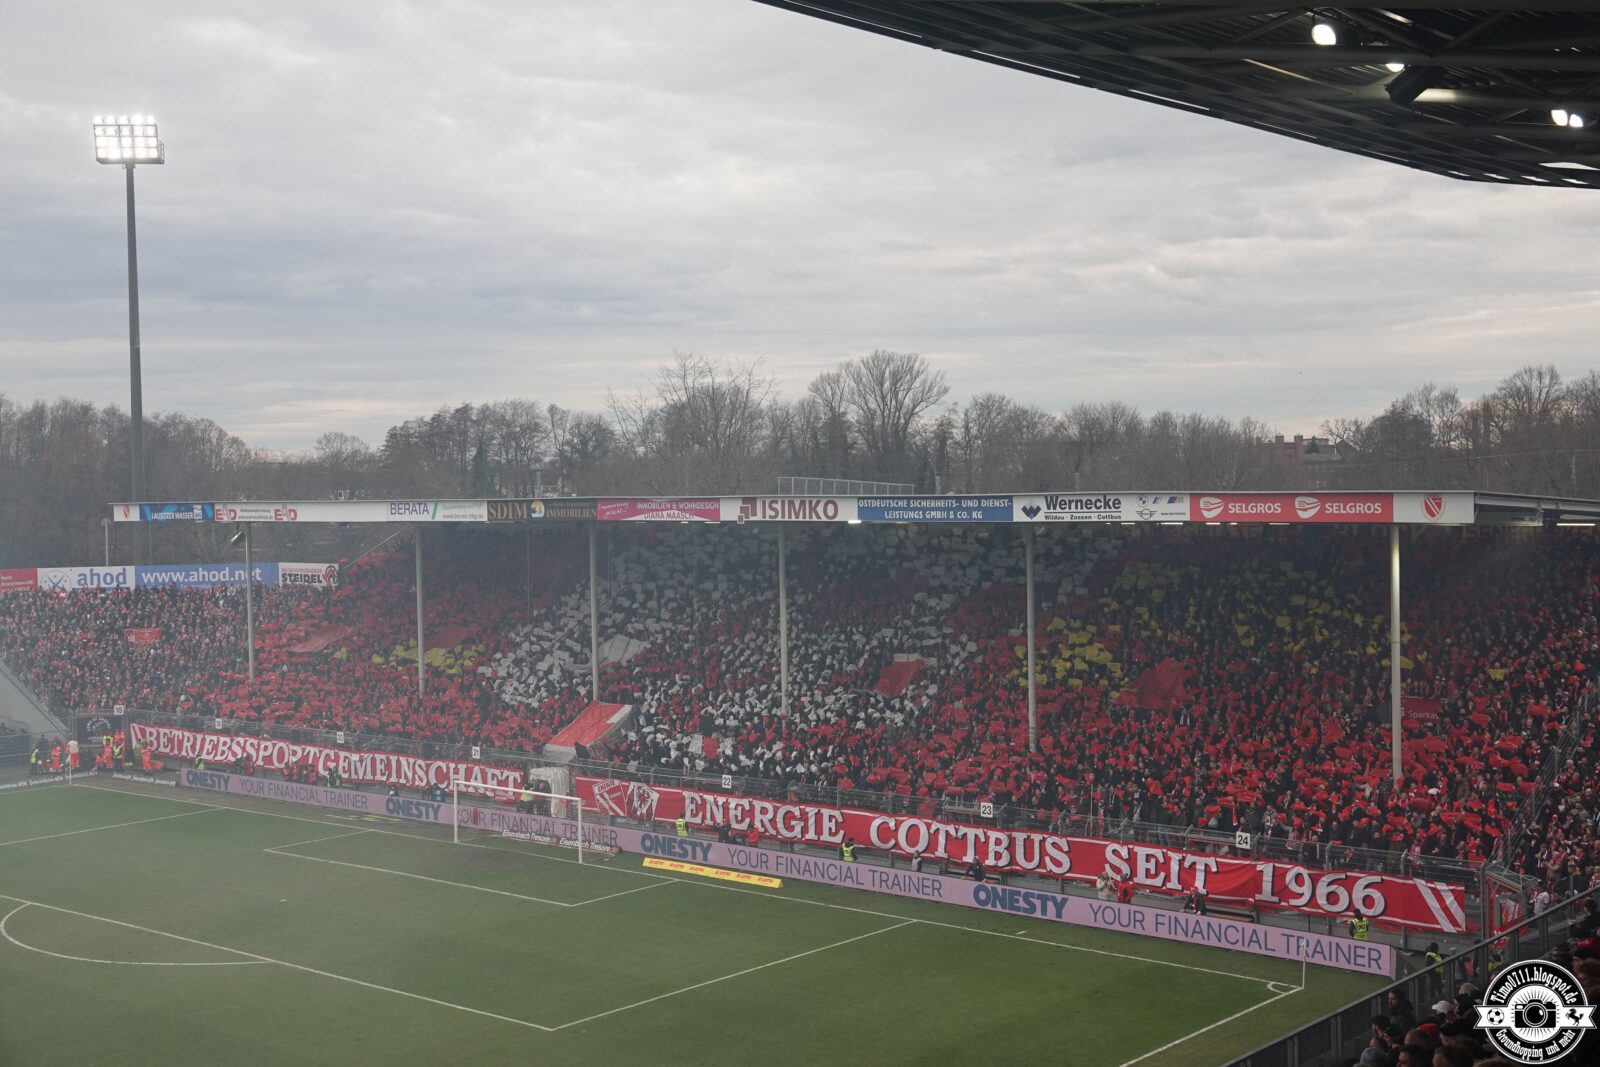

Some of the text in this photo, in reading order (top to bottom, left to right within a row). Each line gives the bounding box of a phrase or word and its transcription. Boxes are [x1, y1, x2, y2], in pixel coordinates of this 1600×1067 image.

[390, 502, 429, 515] BERATA
[636, 501, 671, 509] IMMOBILIEN
[679, 501, 719, 509] WOHNDESIGN
[858, 499, 1012, 508] OSTDEUTSCHE SICHERHEITS- UND DIENST-
[1044, 495, 1122, 511] Wernecke
[1228, 503, 1282, 514] SELGROS
[1325, 502, 1382, 514] SELGROS
[488, 502, 528, 519] SDIM
[545, 508, 597, 518] IMMOBILIEN
[762, 499, 838, 520] ISIMKO
[884, 511, 983, 519] LEISTUNGS GMBH & CO. KG
[151, 512, 193, 520] LAUSITZER WASSER
[644, 511, 694, 520] DIANA MAASCH
[77, 567, 127, 586] ahod
[281, 573, 323, 583] STEIDEL
[337, 732, 344, 742] 20
[472, 747, 480, 757] 21
[143, 726, 522, 798] BETRIEBSSPORTGEMEINSCHAFT
[722, 776, 731, 786] 22
[981, 804, 992, 815] 23
[559, 838, 589, 849] Eisenbch
[1237, 834, 1248, 846] 24
[681, 790, 1387, 918] ENERGIE COTTBUS SEIT 1966
[186, 769, 230, 790] ONESTY
[239, 778, 265, 795] YOUR
[268, 783, 321, 804] FINANCIAL
[323, 790, 368, 810] TRAINER
[385, 796, 441, 821] ONESTY
[491, 811, 555, 837] FINANCIAL
[561, 822, 618, 847] TRAINER
[640, 832, 713, 863] ONESTY
[728, 847, 769, 871] YOUR
[776, 854, 864, 886] FINANCIAL
[868, 868, 943, 898] TRAINER
[972, 883, 1069, 919] ONESTY
[1089, 902, 1146, 931] YOUR
[1155, 913, 1275, 951] FINANCIAL
[1281, 933, 1382, 970] TRAINER
